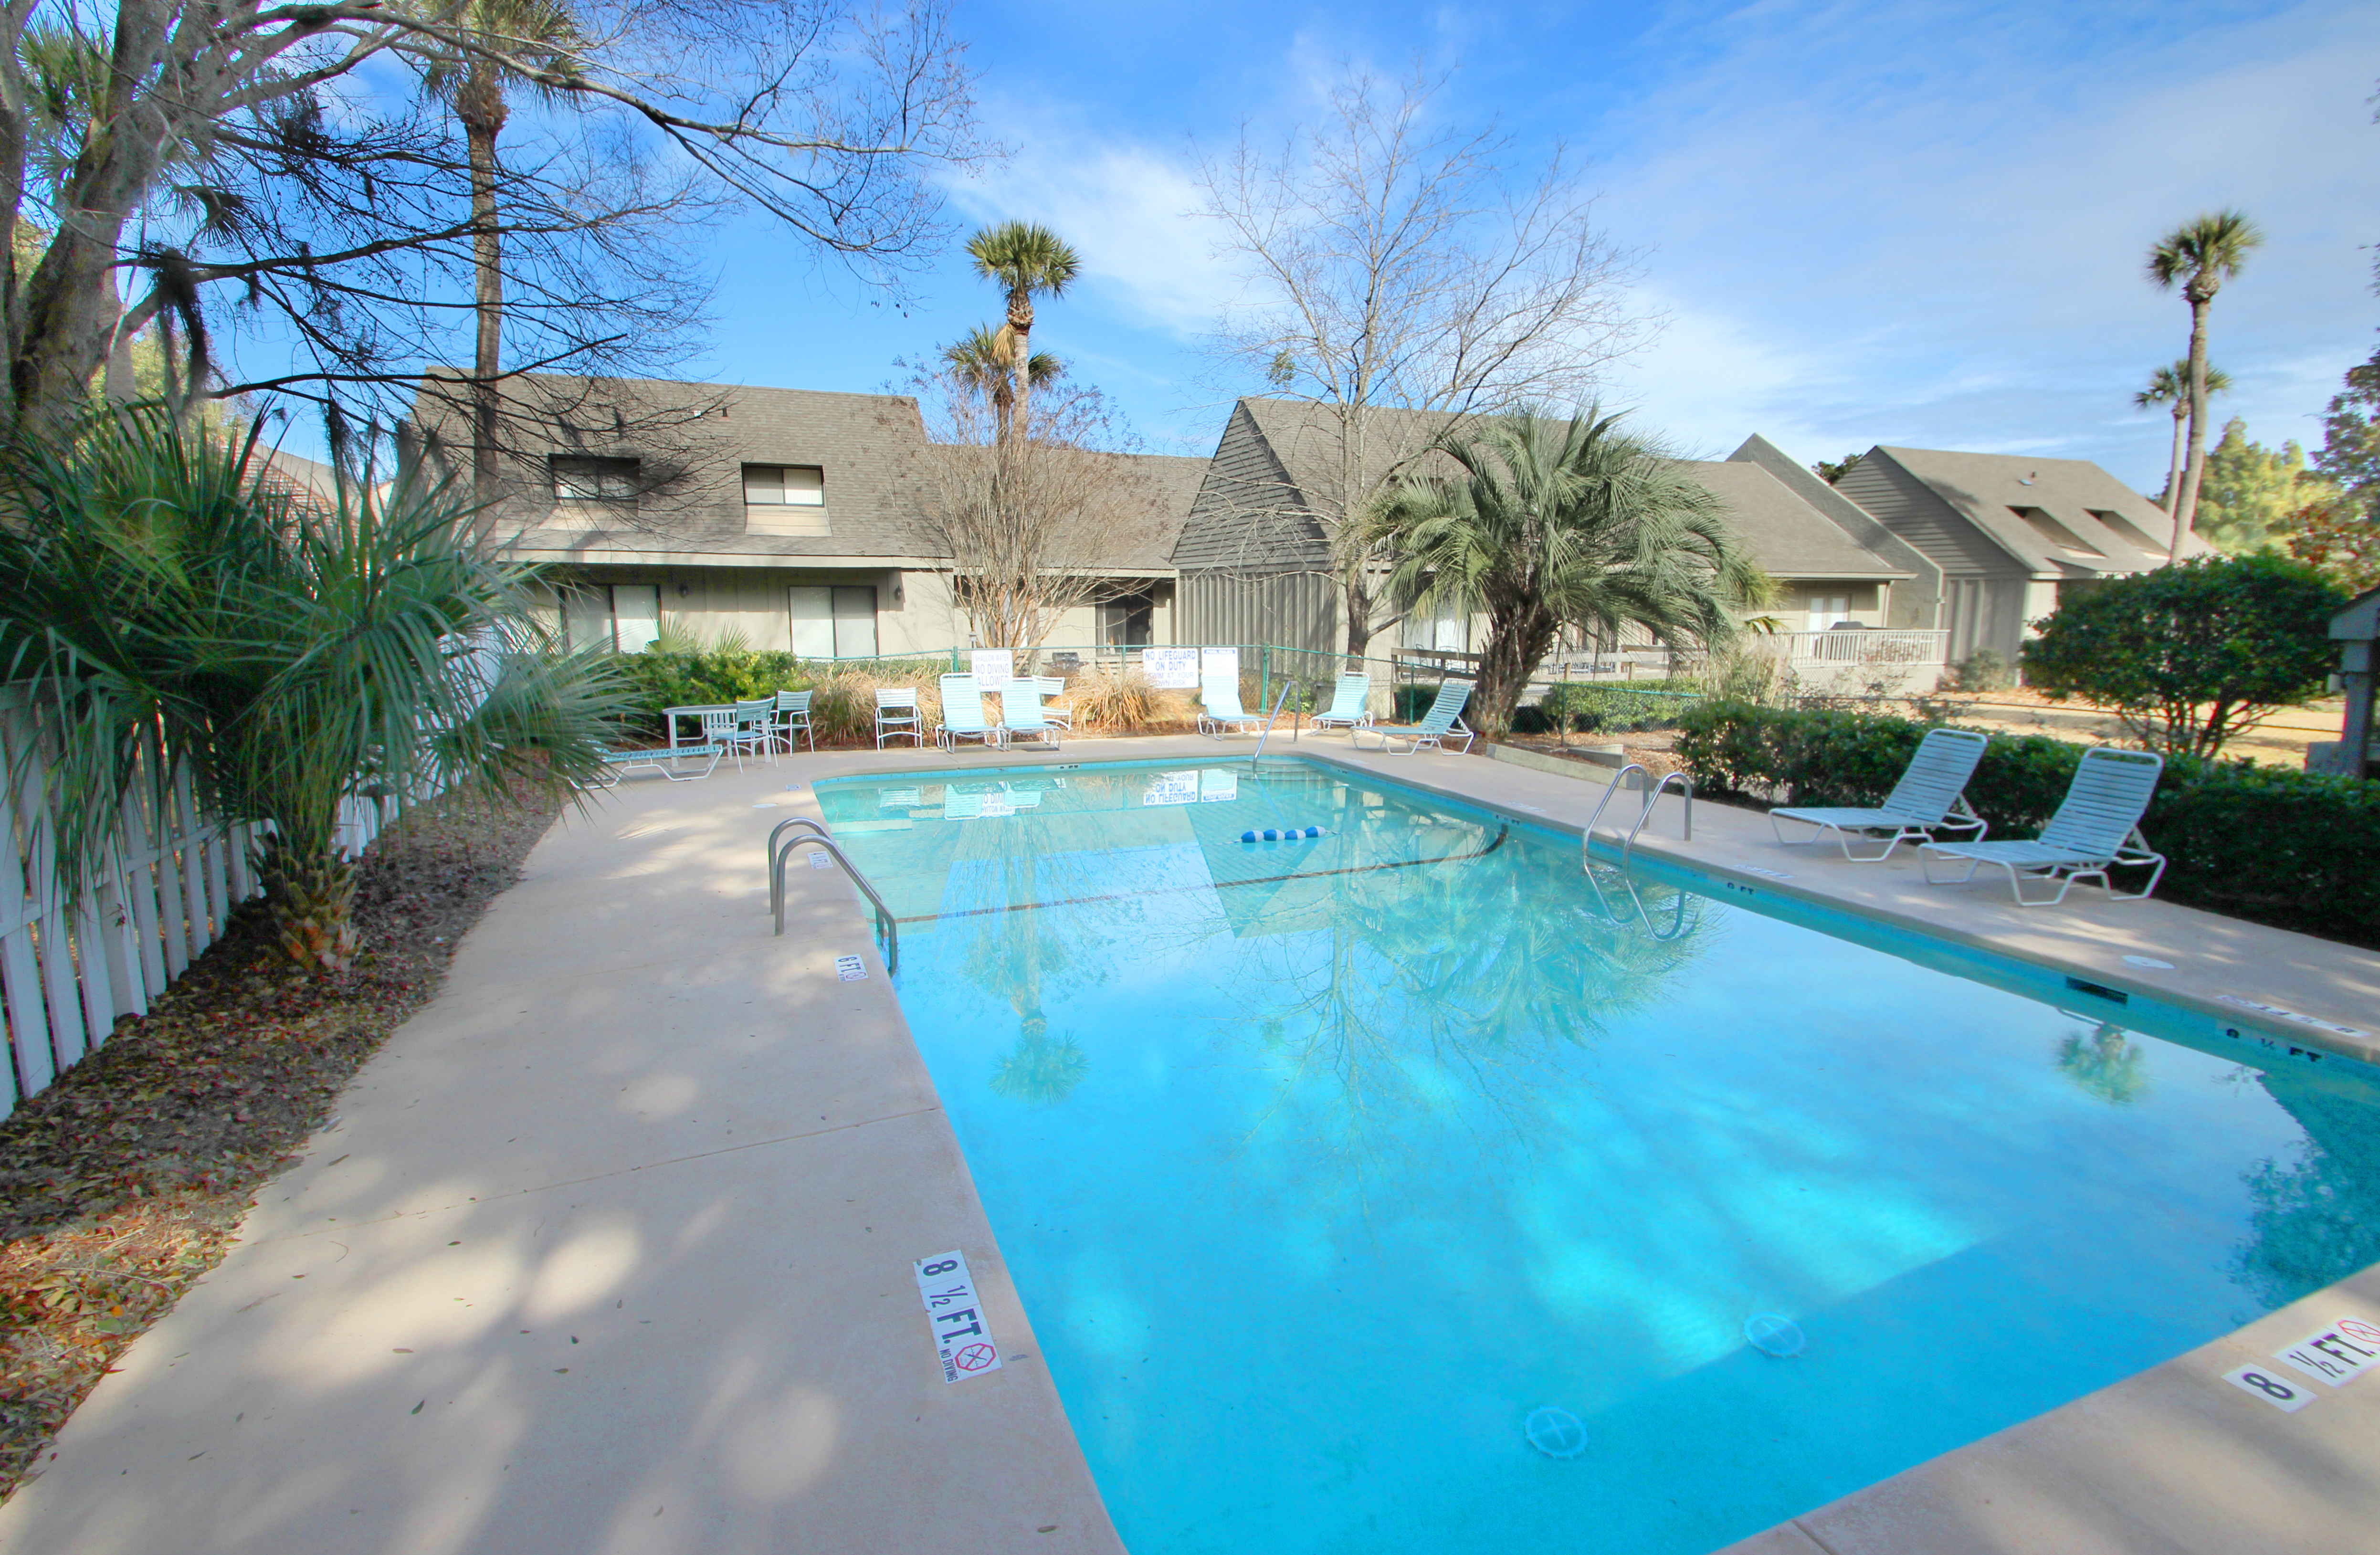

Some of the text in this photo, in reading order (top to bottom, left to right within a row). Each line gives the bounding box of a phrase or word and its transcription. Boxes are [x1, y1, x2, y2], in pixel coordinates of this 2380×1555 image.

[1146, 650, 1196, 660] NO LIFEGUARD
[976, 663, 1009, 674] NO DIVING
[1156, 661, 1186, 671] ON DUTY
[923, 1260, 958, 1276] 8
[937, 1308, 982, 1344] FT.
[939, 1348, 958, 1382] NO DIVING
[2242, 1373, 2296, 1400] 8
[2309, 1333, 2377, 1367] FT.
